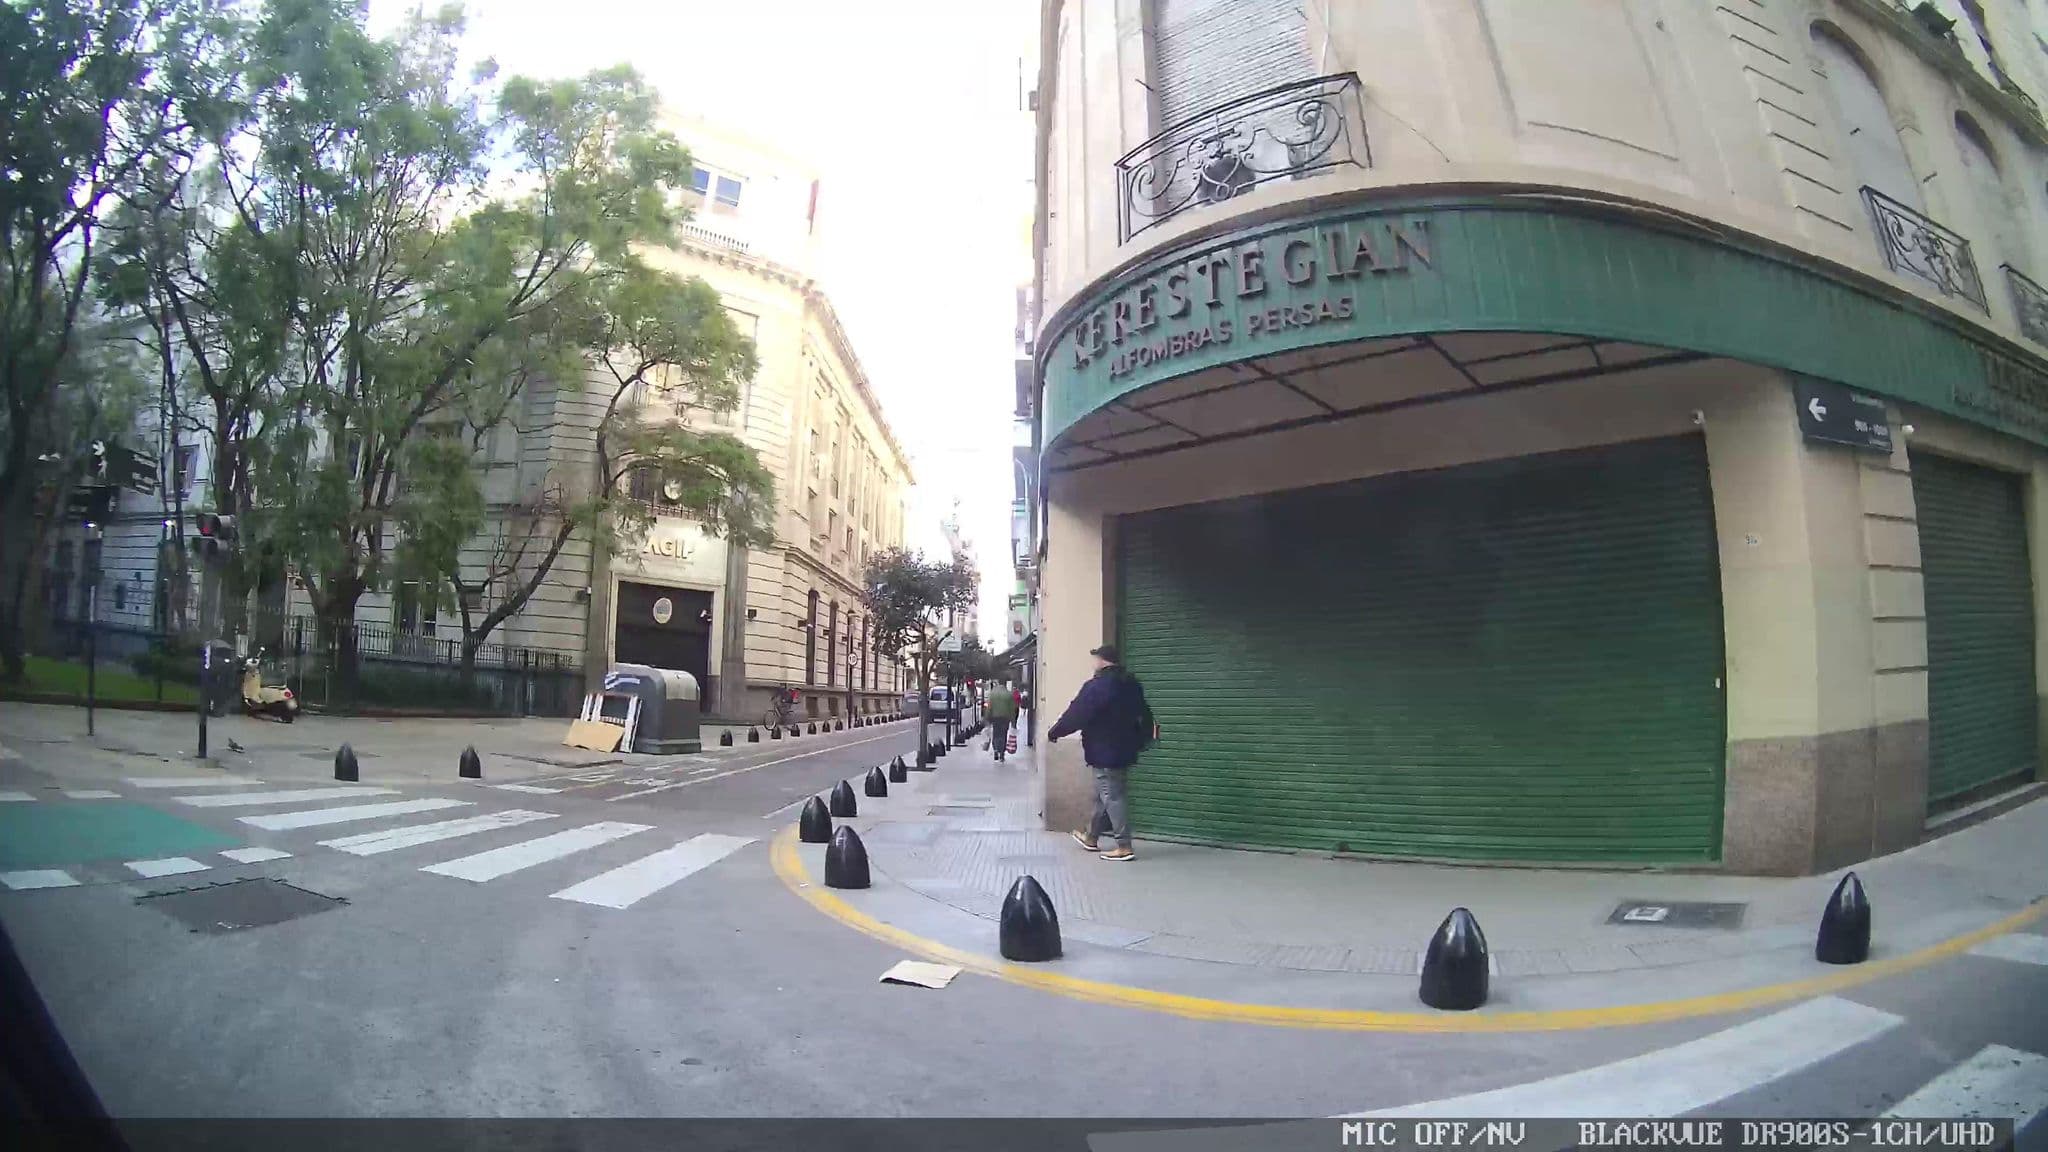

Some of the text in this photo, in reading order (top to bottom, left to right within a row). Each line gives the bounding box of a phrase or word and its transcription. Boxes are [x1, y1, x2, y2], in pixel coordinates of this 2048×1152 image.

[1073, 218, 1433, 371] KERESTEGIAN
[1109, 296, 1355, 379] ALFOMBRAS PERSAS
